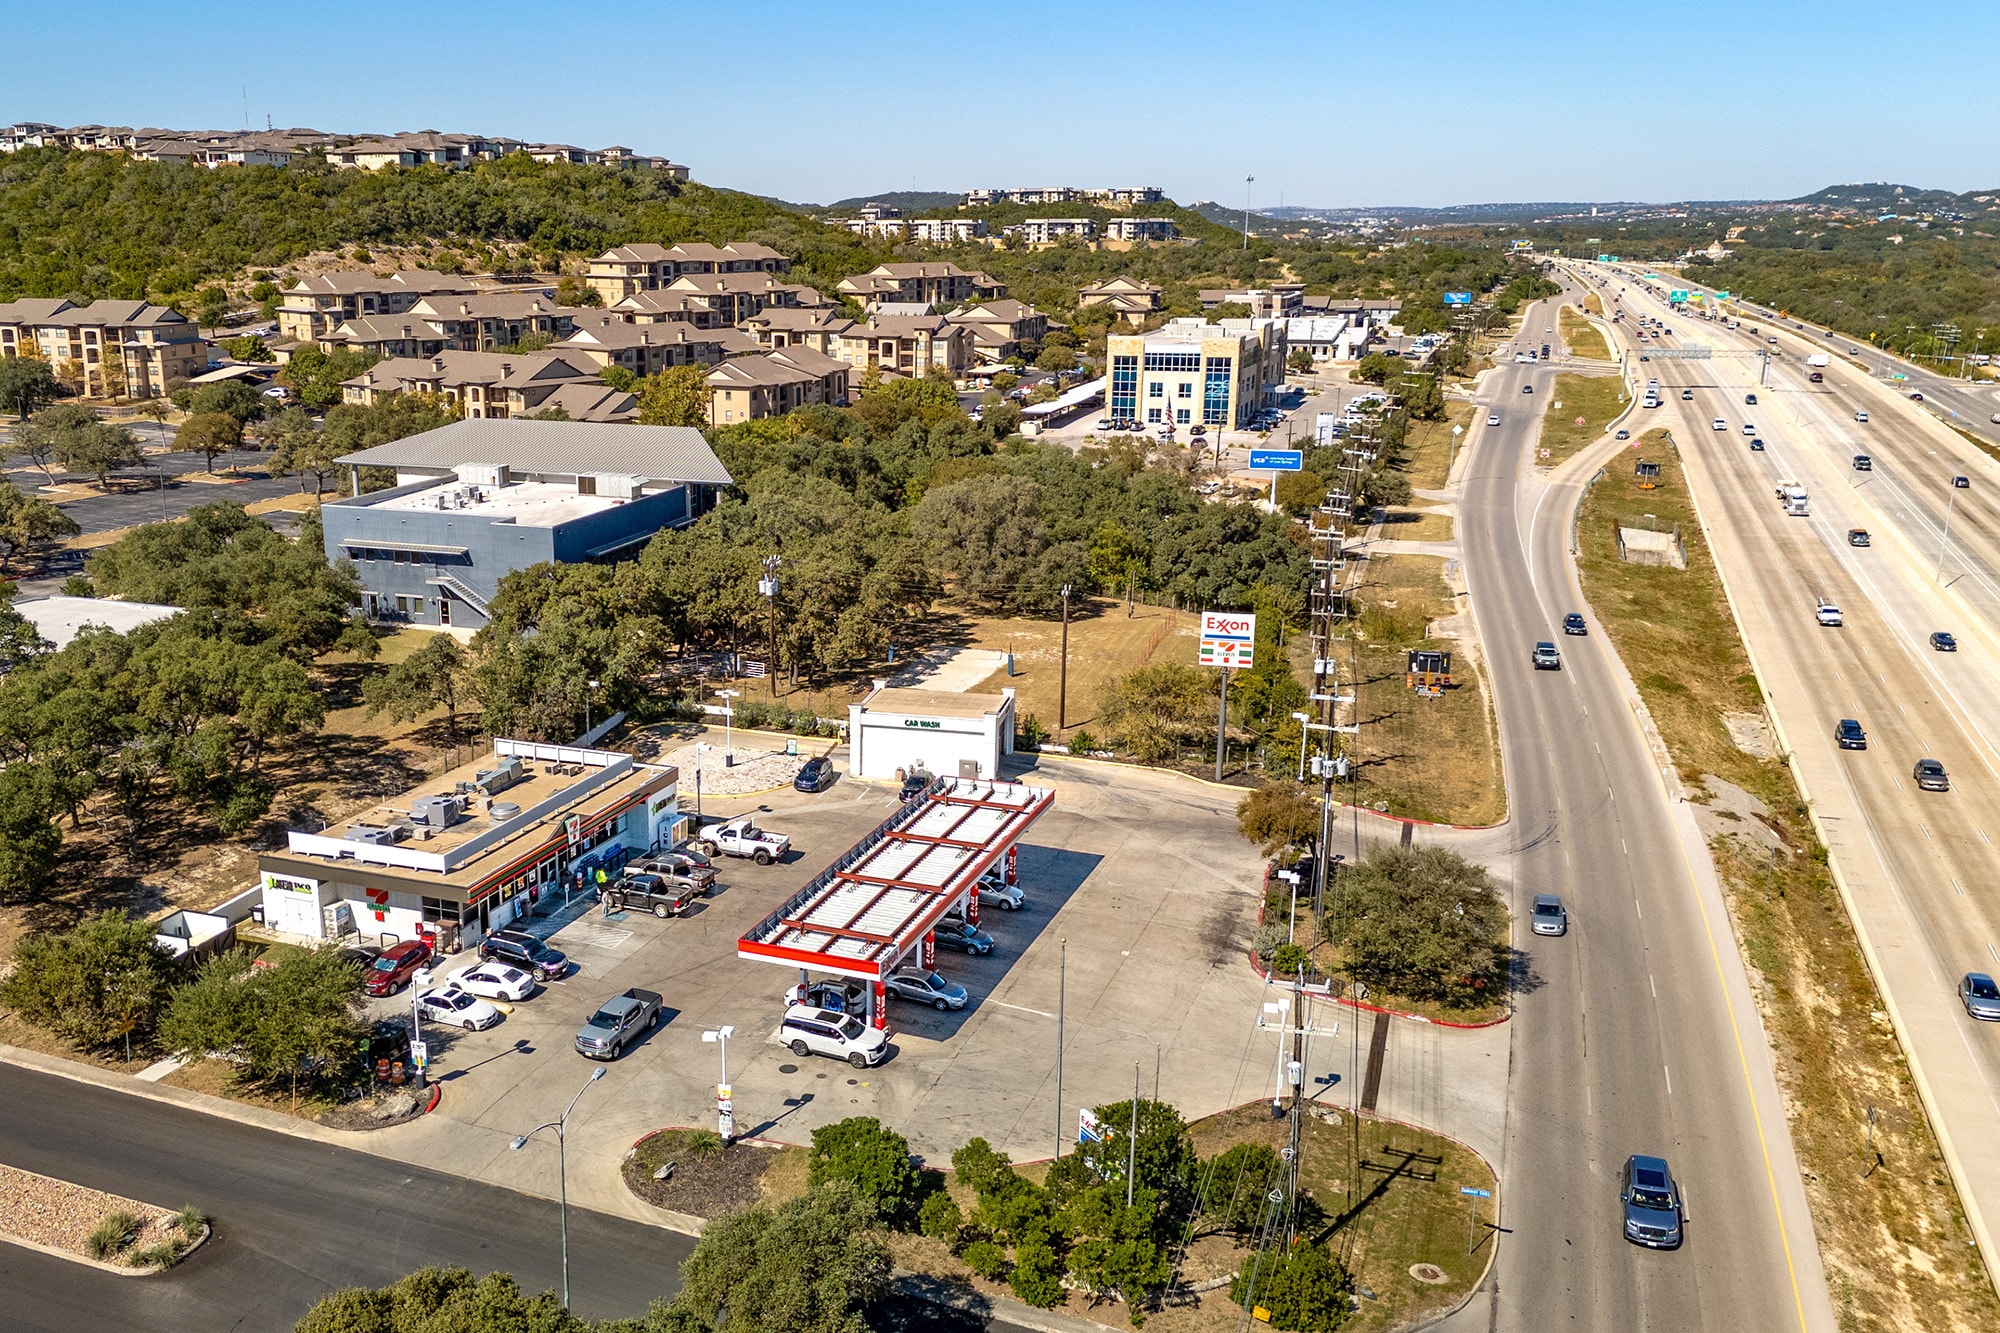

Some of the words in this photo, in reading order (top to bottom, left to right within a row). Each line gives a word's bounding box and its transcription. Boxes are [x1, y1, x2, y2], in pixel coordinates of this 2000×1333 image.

[1207, 617, 1250, 634] Exxon
[904, 719, 919, 727] CAR
[919, 720, 941, 729] WASH
